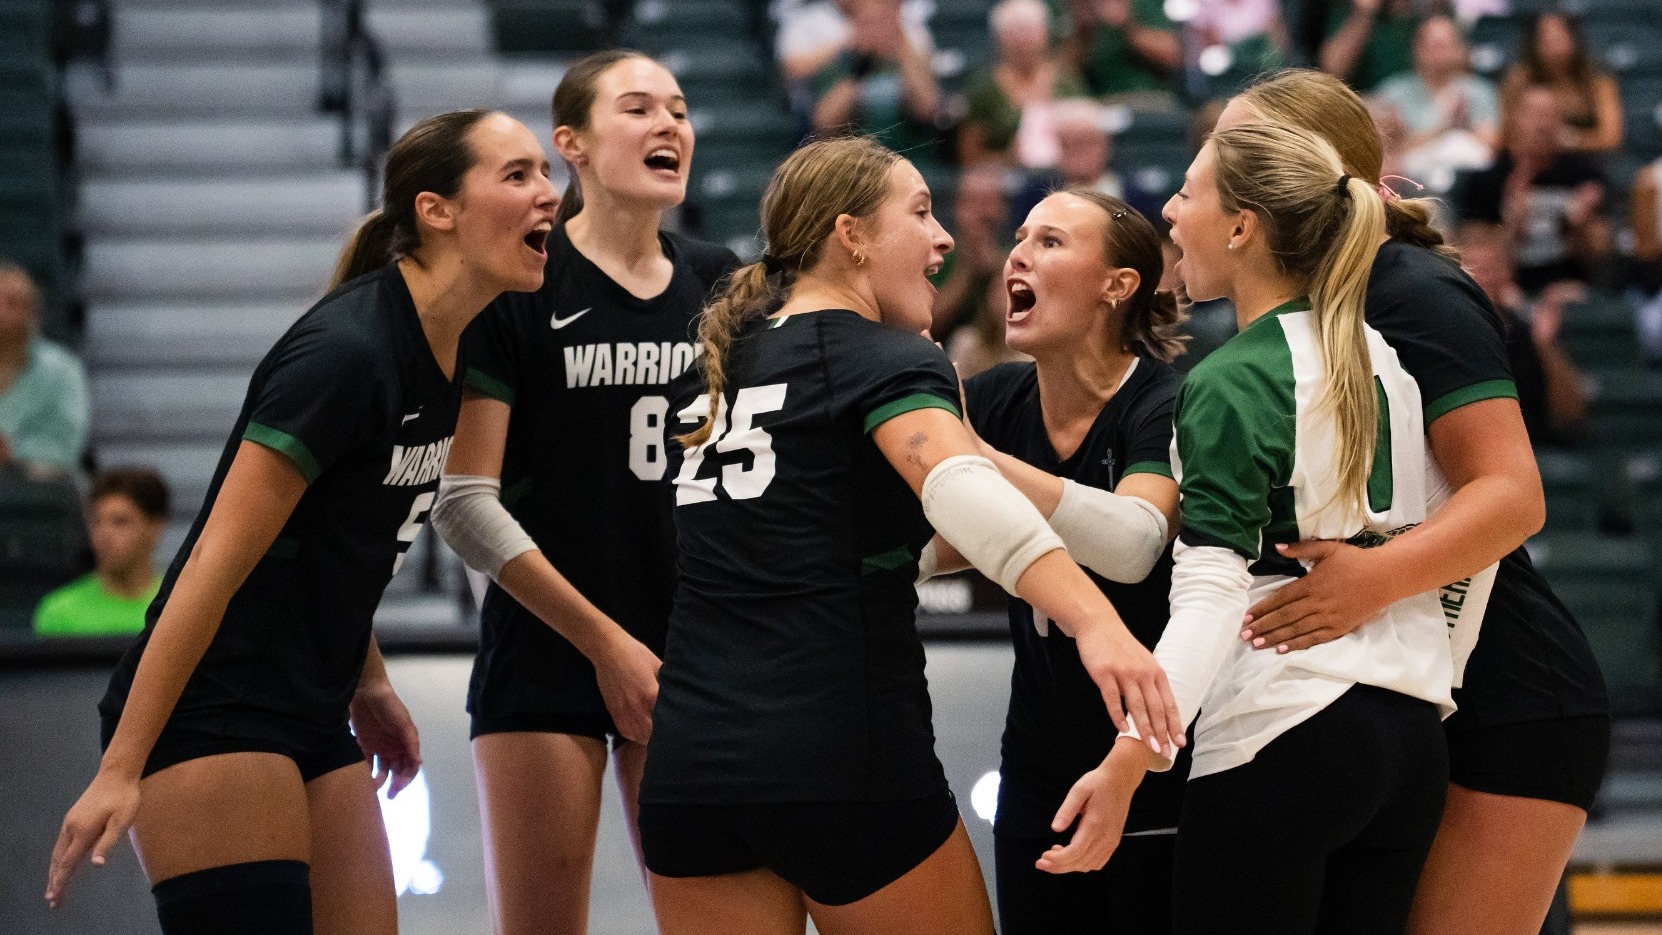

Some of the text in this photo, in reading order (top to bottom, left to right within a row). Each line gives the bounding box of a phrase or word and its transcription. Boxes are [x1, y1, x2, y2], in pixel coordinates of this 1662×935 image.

[563, 341, 704, 389] WARRIO
[629, 395, 670, 481] 8
[672, 383, 788, 507] 25
